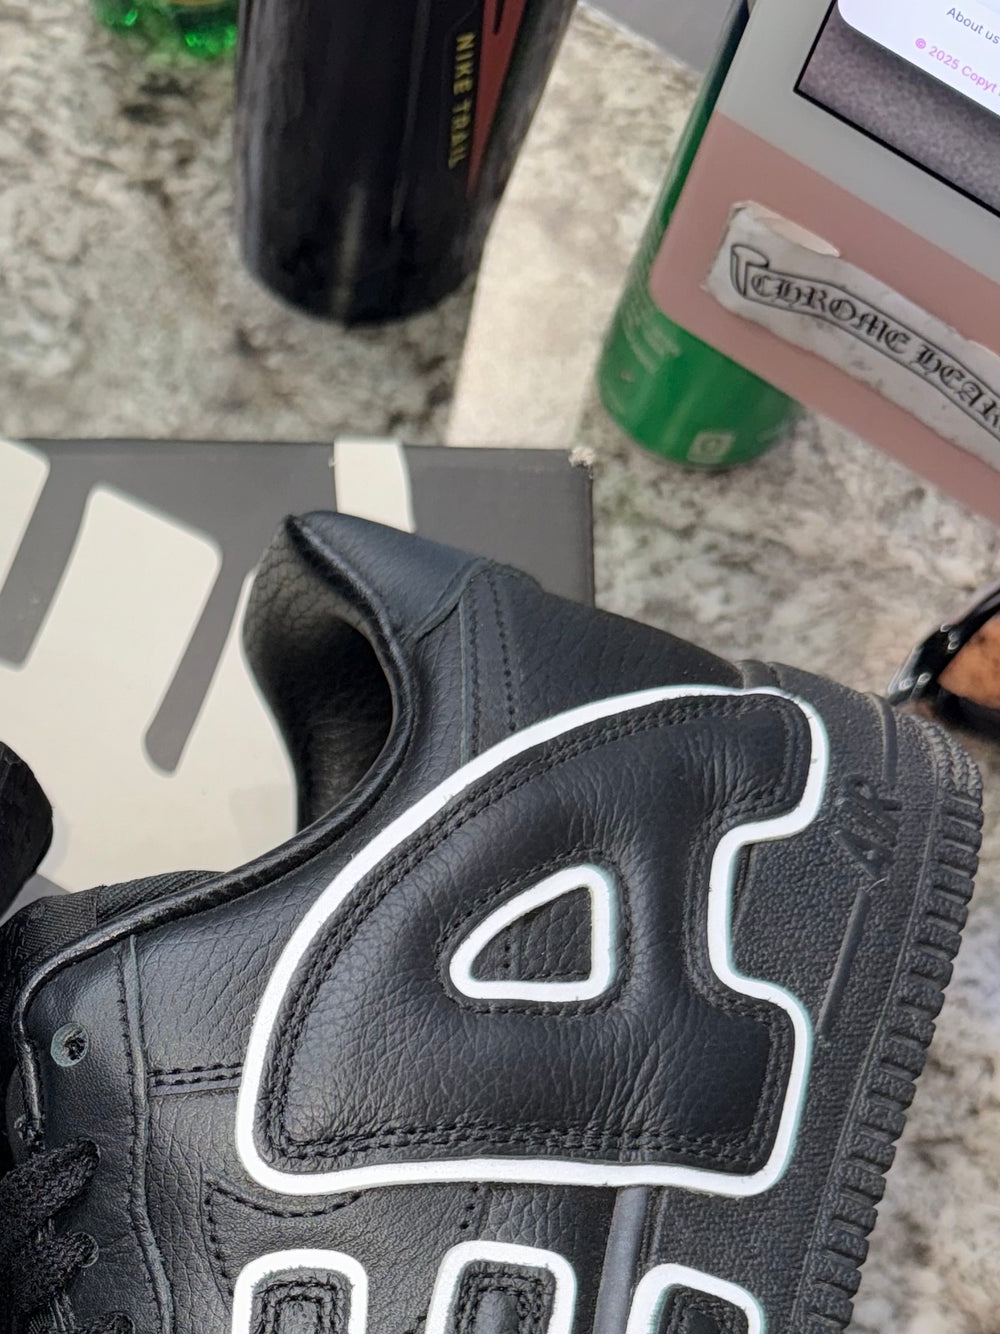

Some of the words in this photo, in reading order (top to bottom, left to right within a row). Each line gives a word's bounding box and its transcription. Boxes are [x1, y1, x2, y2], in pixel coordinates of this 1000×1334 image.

[946, 7, 984, 35] About
[985, 30, 1000, 44] us
[453, 32, 476, 96] NIKE
[928, 46, 960, 70] 2025
[448, 99, 472, 170] TRAIL
[750, 274, 910, 354] CHROME
